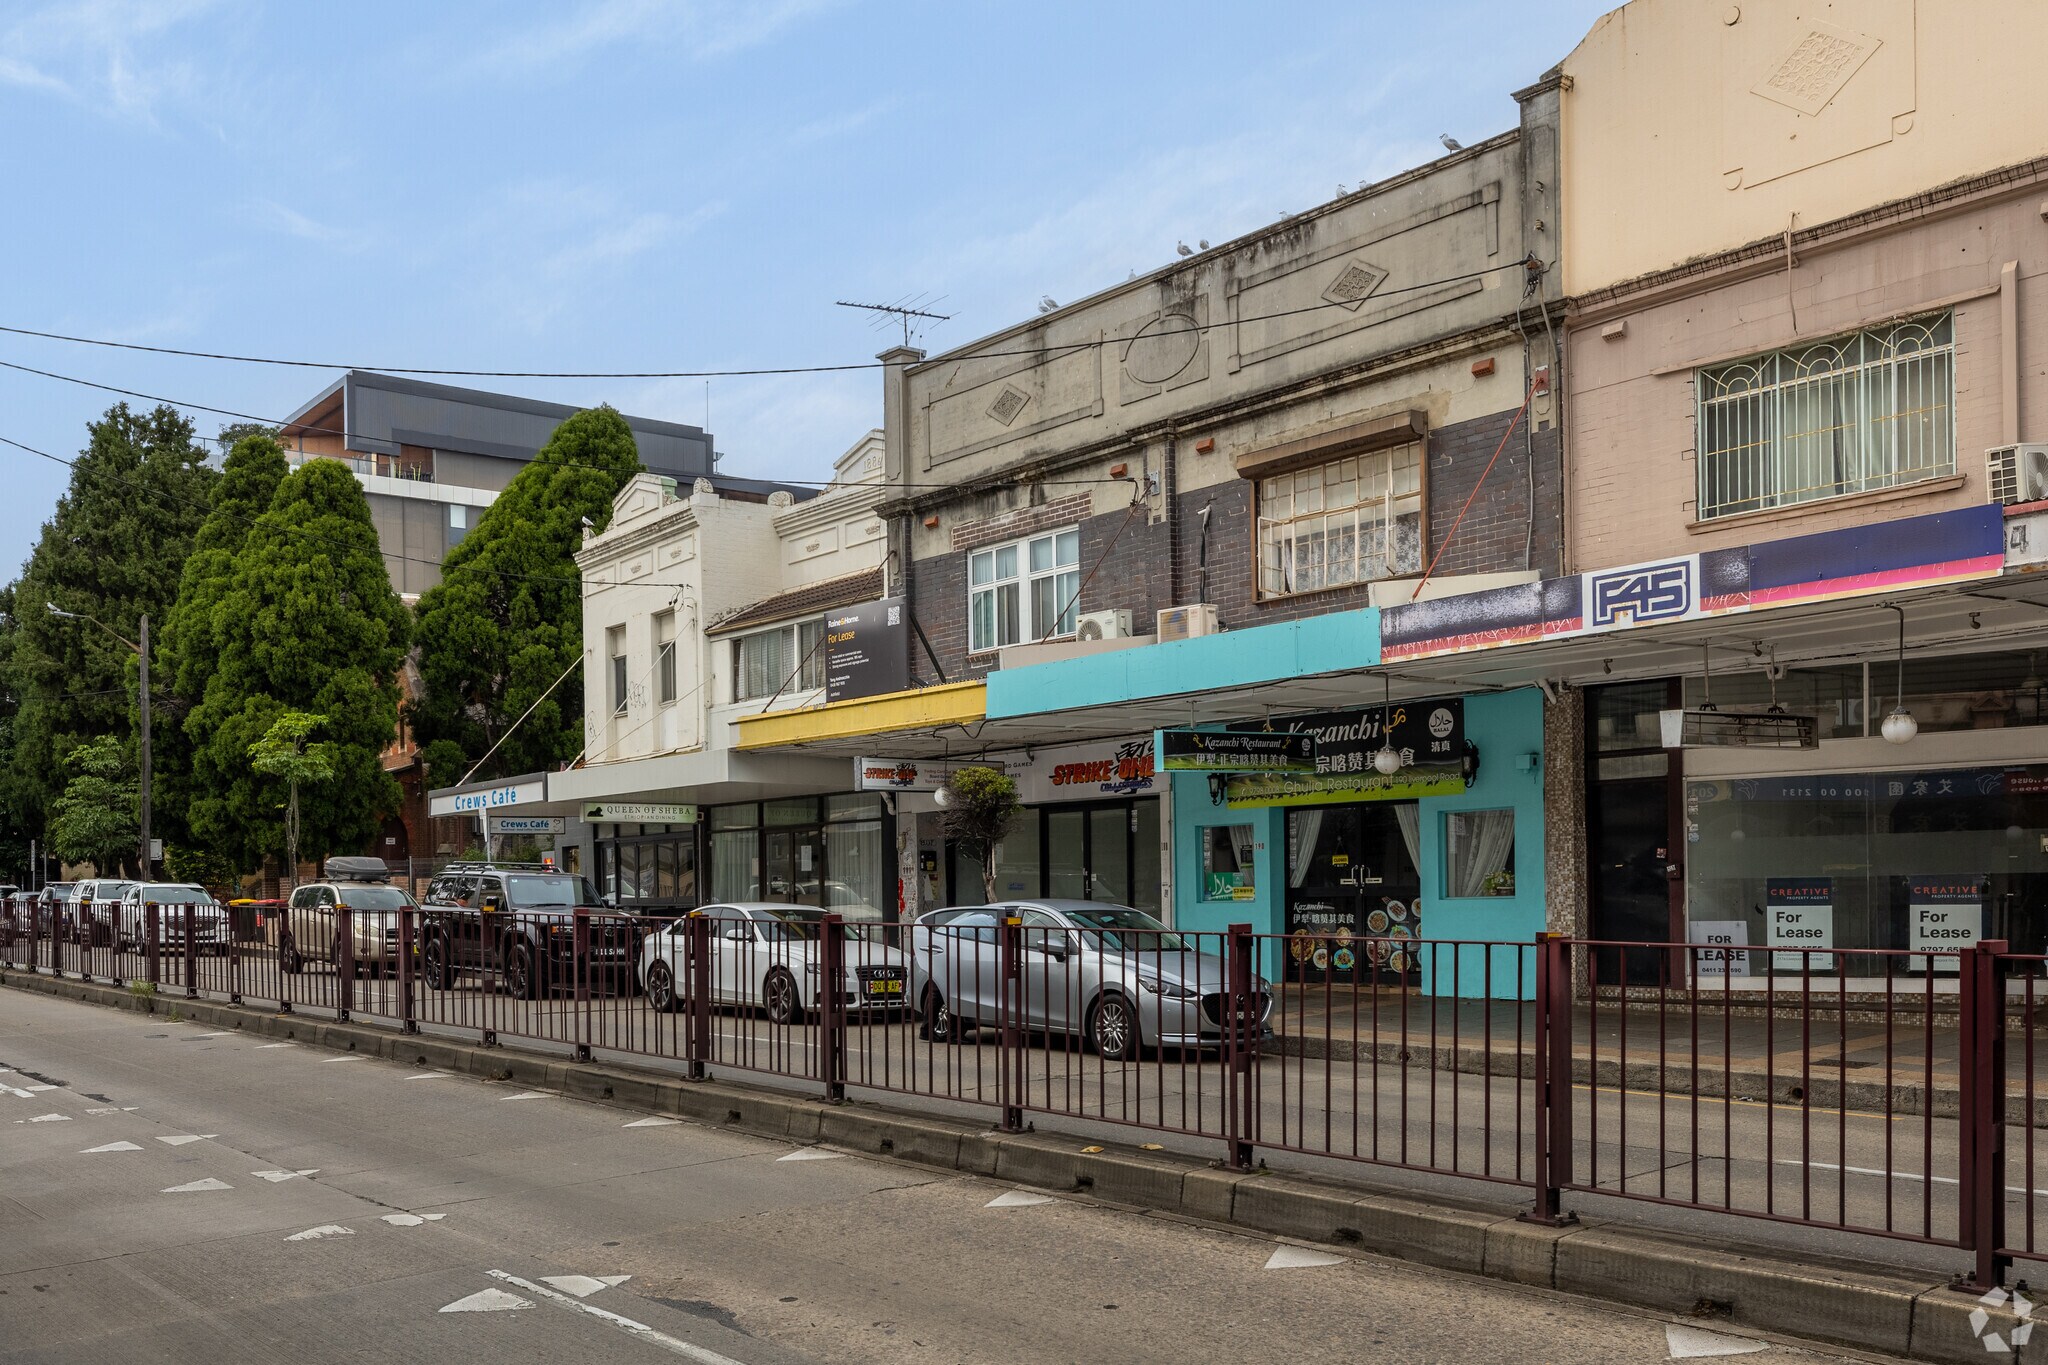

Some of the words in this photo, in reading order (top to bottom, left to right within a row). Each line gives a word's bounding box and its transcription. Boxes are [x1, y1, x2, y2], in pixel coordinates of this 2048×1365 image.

[1597, 566, 1686, 619] F45
[828, 633, 837, 643] For
[838, 631, 855, 641] Lease
[1205, 736, 1239, 749] Kazanchi
[1240, 738, 1281, 750] Restaurant
[1431, 741, 1451, 752] 清真
[864, 767, 895, 779] STRIKE
[1052, 760, 1113, 785] STRIKE
[1118, 755, 1155, 779] ONE
[1327, 775, 1393, 791] Restaurant
[1440, 772, 1461, 781] Road
[455, 794, 487, 810] Crews
[491, 787, 517, 805] Café
[607, 806, 641, 814] QUEEN
[659, 807, 690, 815] SHEBA
[501, 820, 527, 828] Crews
[530, 818, 549, 828] Café
[1770, 888, 1829, 896] CREATIVE
[1913, 886, 1978, 895] CREATIVE
[1293, 902, 1324, 912] Kazanchi
[1776, 912, 1802, 923] For
[1920, 911, 1948, 922] For
[1776, 927, 1823, 938] Lease
[1920, 926, 1971, 938] Lease
[1707, 935, 1732, 943] FOR
[1696, 950, 1746, 961] LEASE
